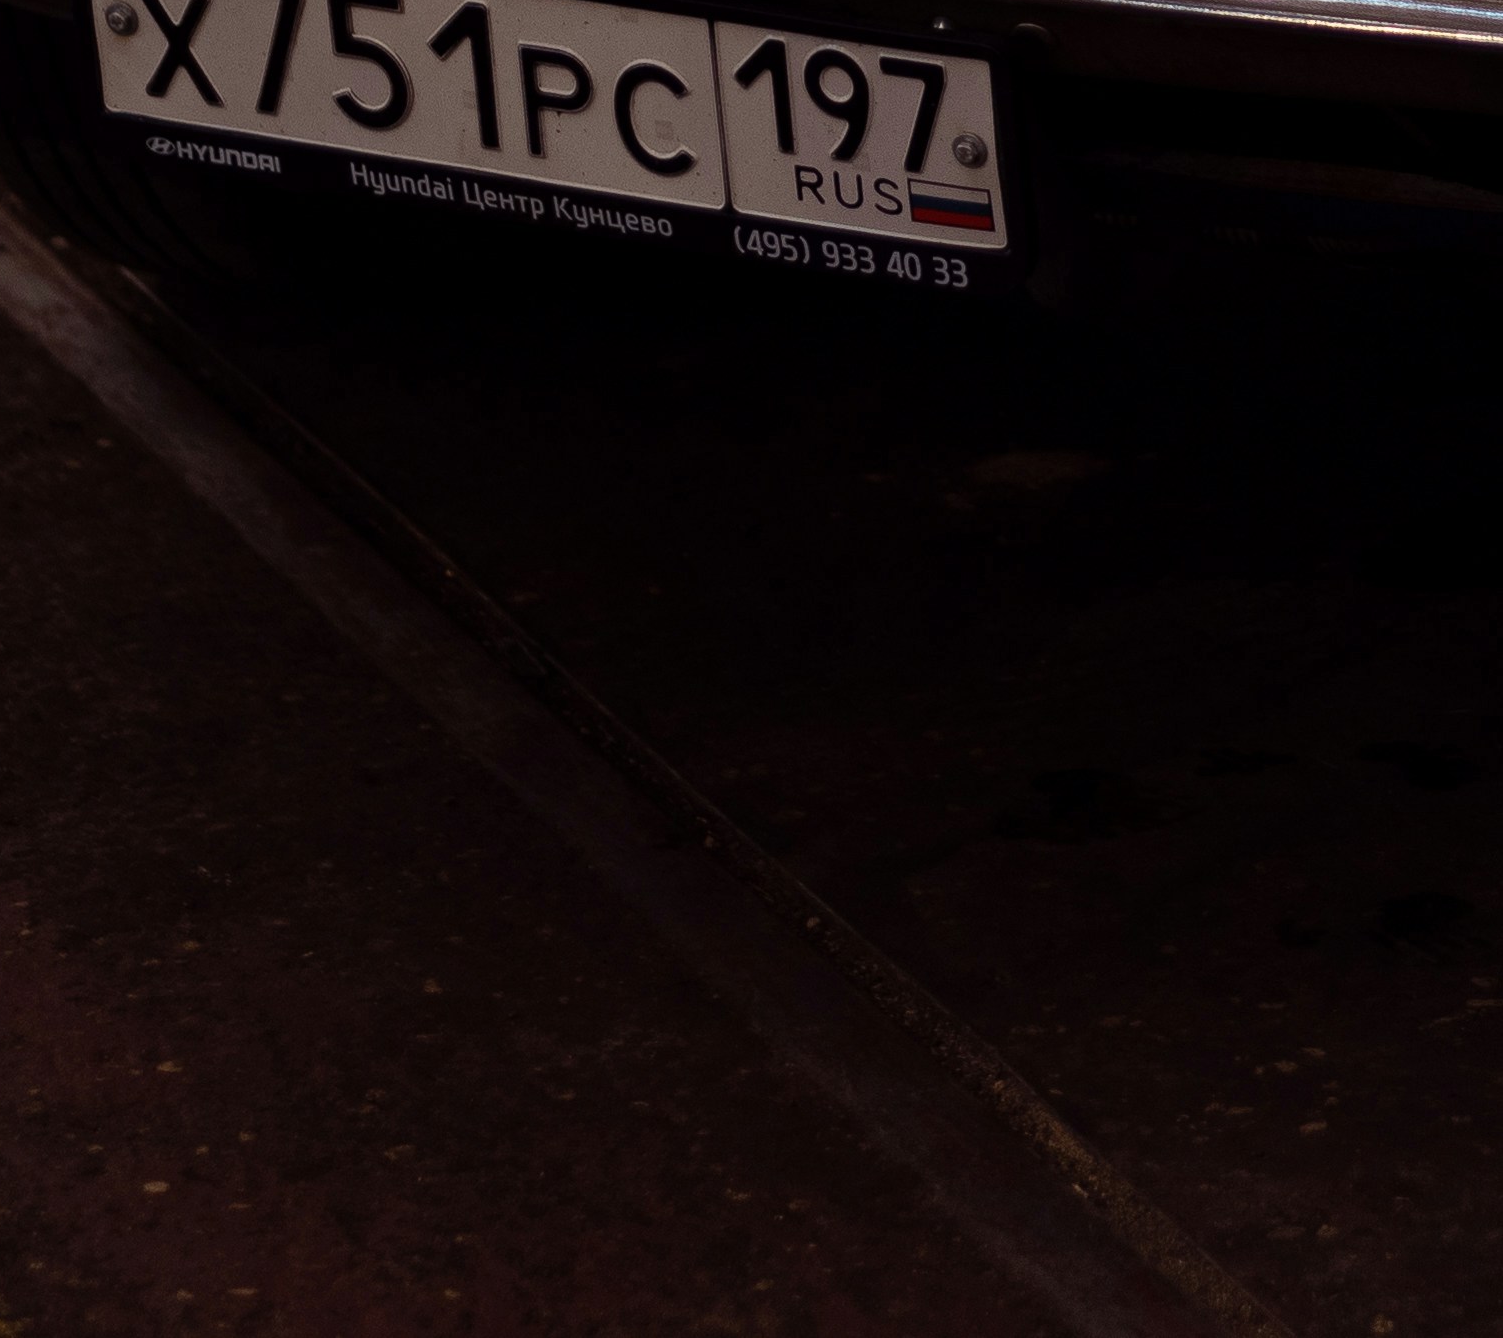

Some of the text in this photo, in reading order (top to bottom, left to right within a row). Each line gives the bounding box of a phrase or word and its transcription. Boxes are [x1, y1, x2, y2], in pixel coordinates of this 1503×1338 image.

[734, 38, 946, 174] 197
[176, 140, 282, 175] HYUNDAI
[350, 161, 674, 238] Hyundai Центр Кунцево
[794, 165, 903, 215] RUS
[733, 224, 969, 288] (495) 933 40 33
